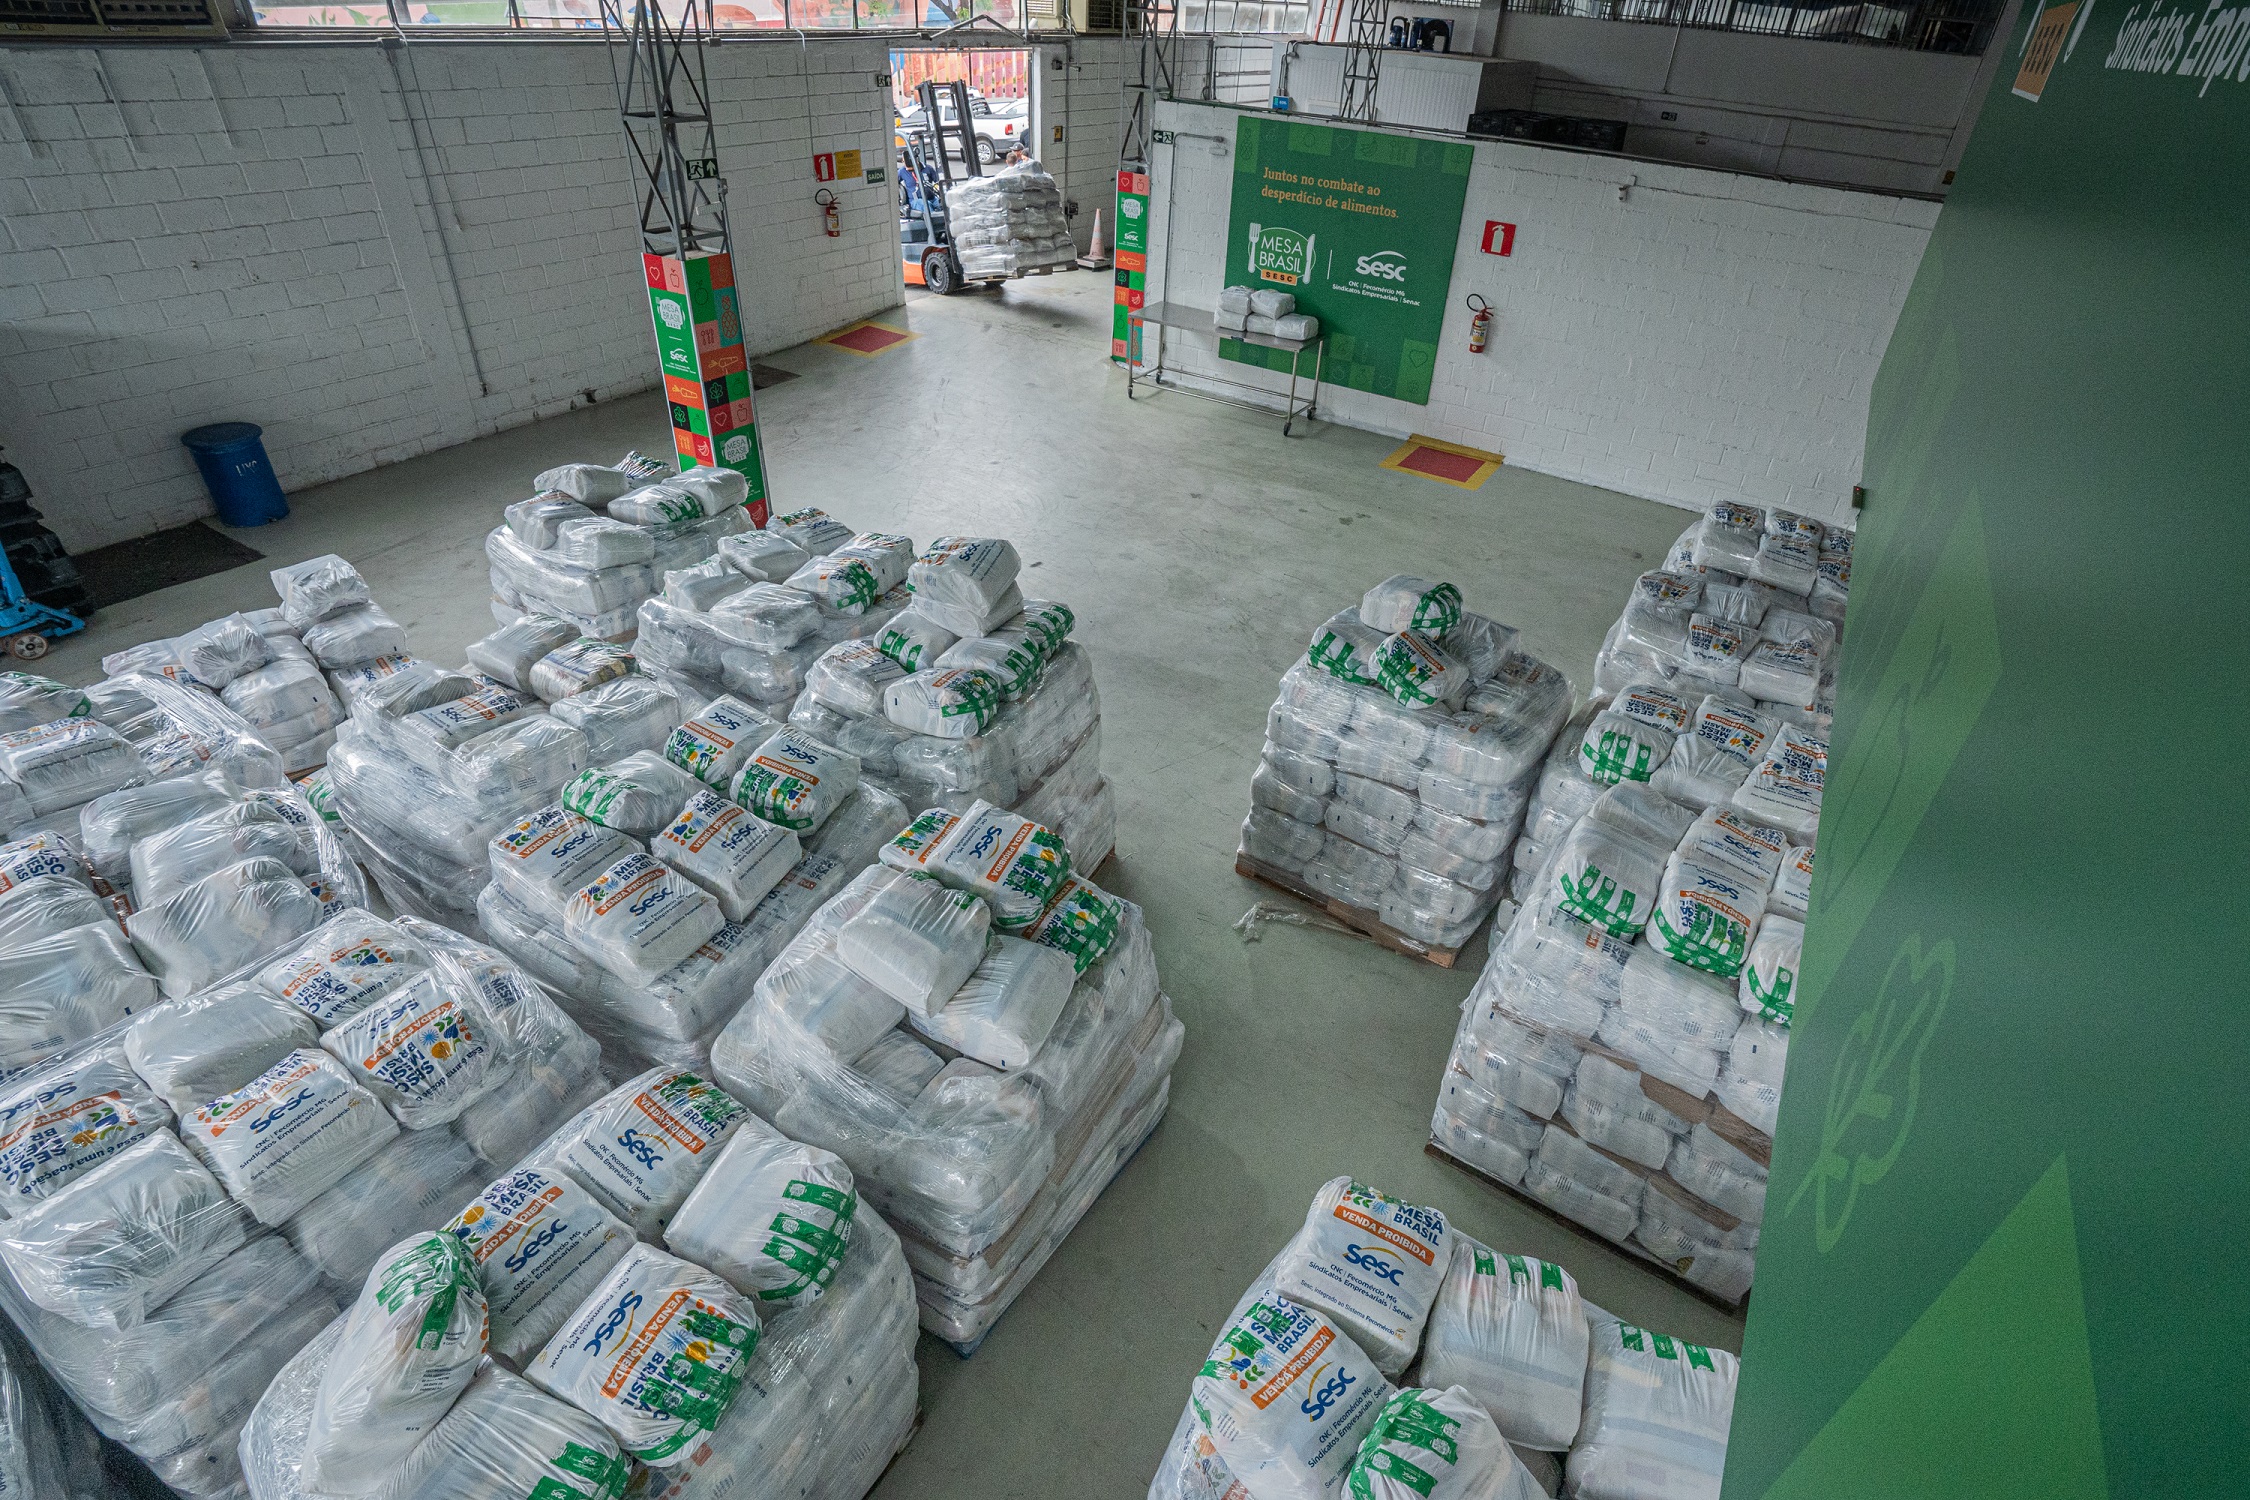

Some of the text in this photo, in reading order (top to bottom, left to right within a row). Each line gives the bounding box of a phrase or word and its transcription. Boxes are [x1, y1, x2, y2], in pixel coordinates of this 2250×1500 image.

[2105, 0, 2195, 74] Sindicatos
[868, 172, 884, 181] SAÍDA
[1263, 167, 1381, 196] Juntos no combate ao
[1261, 185, 1399, 218] desperdício de alimentos.
[1259, 251, 1302, 273] BRASIL
[1261, 235, 1303, 256] MESA
[1265, 271, 1293, 283] SESC
[1698, 729, 1727, 744] SESC
[1701, 724, 1730, 739] MESA
[694, 828, 717, 849] VENDA
[1016, 825, 1031, 848] VENDA
[613, 854, 650, 877] MESA
[621, 861, 658, 882] BRASIL
[990, 846, 1016, 877] PROIBIDA
[600, 870, 662, 911] VENDA PROIBIDA
[239, 1089, 351, 1170] Sindicatos Empresariais Senac
[255, 1097, 328, 1149] CNC Fecomércio MG
[266, 1150, 294, 1170] integrado
[300, 1128, 323, 1147] Sistema
[321, 1107, 351, 1131] Fecomércio
[640, 1096, 666, 1124] VENDA
[664, 1118, 698, 1149] PROIBIDA
[683, 1109, 716, 1138] BRASIL
[583, 1138, 652, 1202] Sindicatos Empresariais Senac
[599, 1143, 645, 1185] CNC Fecomércio MG
[491, 1172, 541, 1211] MESA
[500, 1179, 550, 1216] BRASIL
[1342, 1209, 1428, 1260] VENDA PROIBIDA
[1393, 1214, 1440, 1247] BRASIL
[1397, 1204, 1445, 1235] MESA
[500, 1279, 535, 1314] Sindicatos
[535, 1240, 580, 1280] Empresariais
[582, 1220, 604, 1239] Senac
[513, 1230, 582, 1291] CNC Fecomércio MG
[526, 1289, 552, 1314] integrado
[551, 1282, 559, 1292] ao
[558, 1266, 580, 1286] Sistema
[578, 1240, 608, 1267] Fecomércio
[1309, 1261, 1414, 1322] Sindicatos Empresariais Senac
[1330, 1263, 1398, 1304] CNC Fecomércio MG
[645, 1293, 686, 1338] VENDA
[1314, 1285, 1338, 1305] integrado
[1338, 1299, 1345, 1308] ao
[1345, 1303, 1365, 1320] Sistema
[1366, 1315, 1395, 1336] Fecomércio
[569, 1335, 581, 1350] MG
[1276, 1315, 1317, 1354] BRASIL
[606, 1329, 653, 1391] PROIBIDA
[620, 1351, 666, 1407] BRASIL
[1259, 1332, 1331, 1402] VENDA PROIBIDA
[1307, 1399, 1374, 1468] Sindicatos Empresariais
[1318, 1386, 1373, 1444] CNC Fecomércio MG
